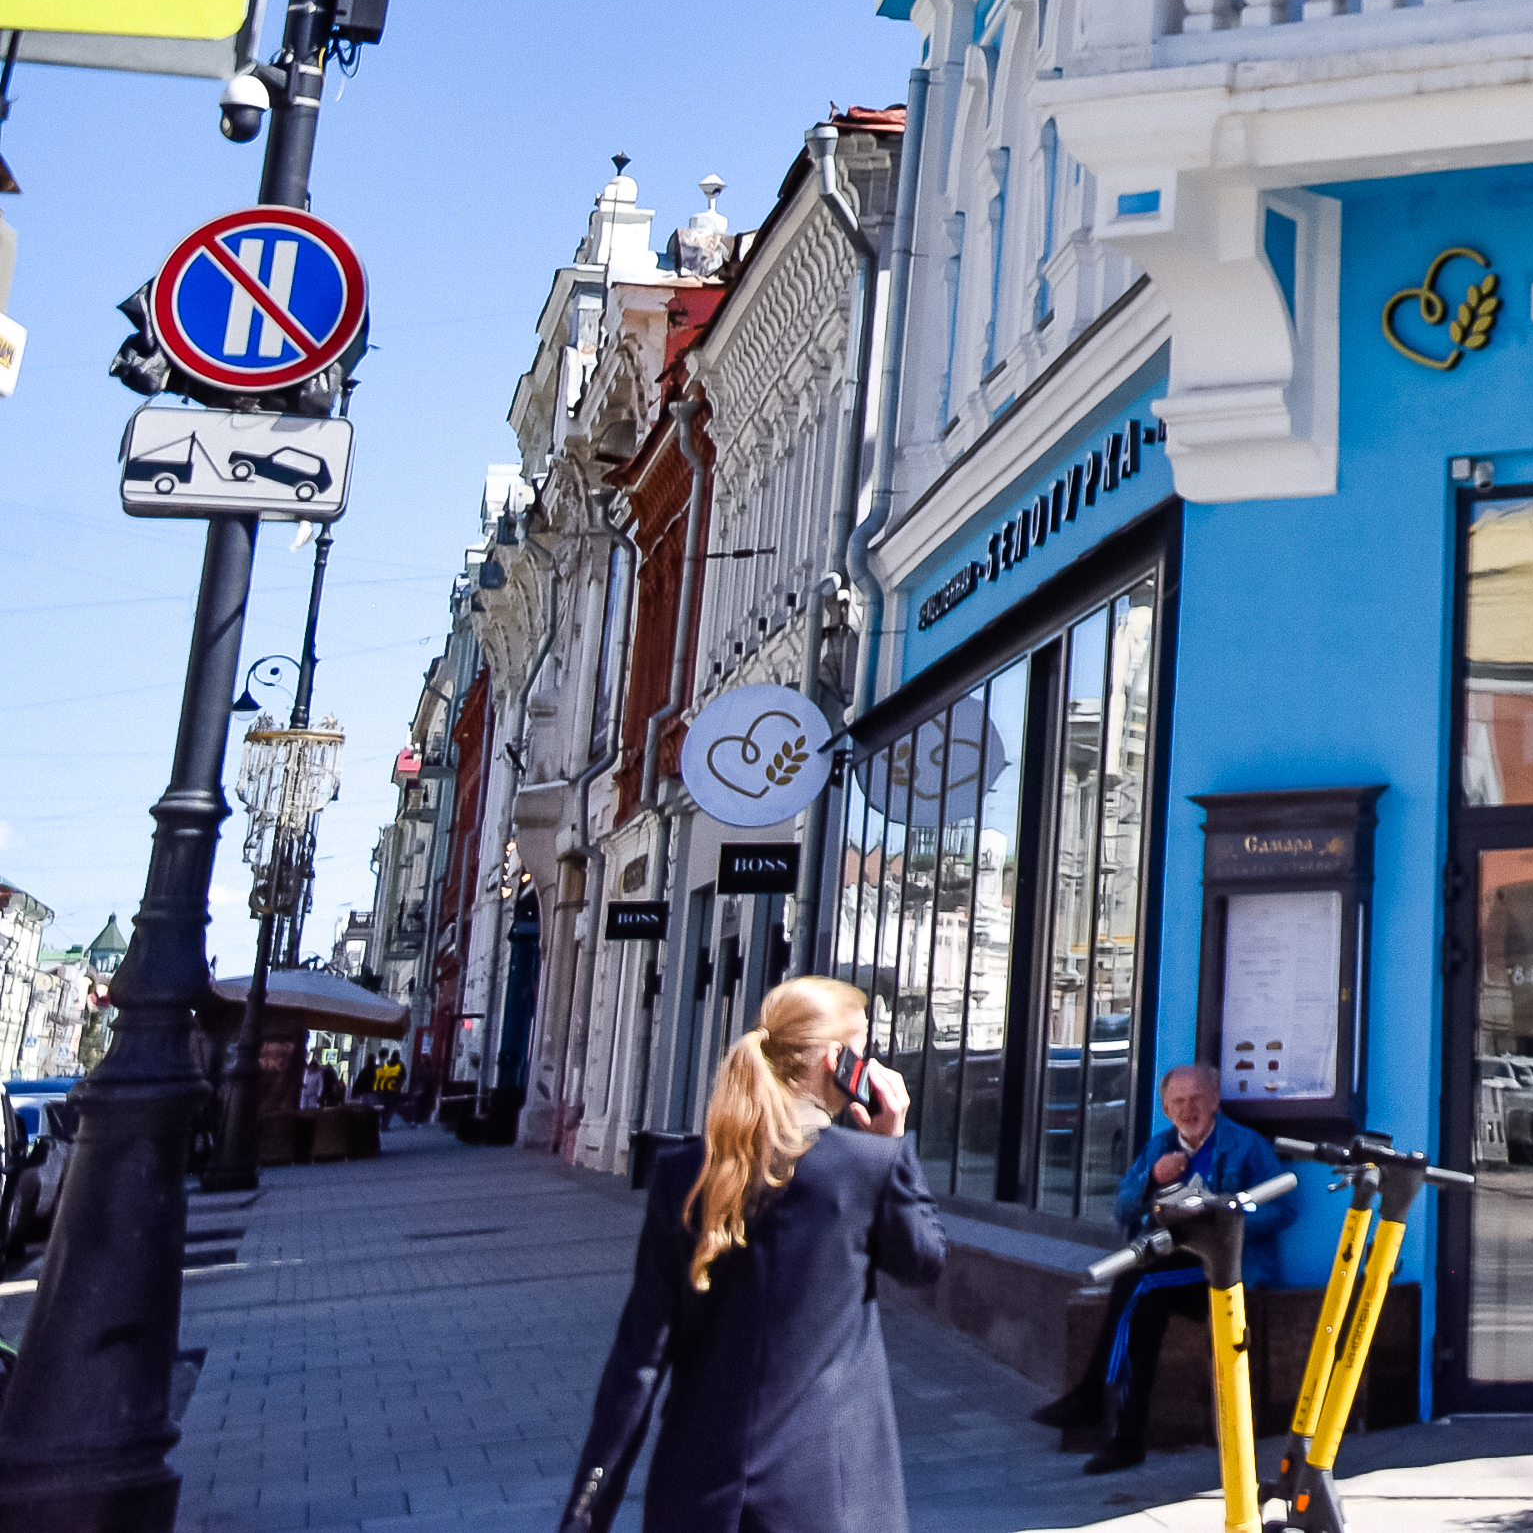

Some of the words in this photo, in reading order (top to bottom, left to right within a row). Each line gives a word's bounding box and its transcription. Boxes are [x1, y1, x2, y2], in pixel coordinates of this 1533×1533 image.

[984, 418, 1139, 582] БЕЛОТУРКА
[734, 857, 788, 872] BOSS
[617, 913, 659, 924] BOSS
